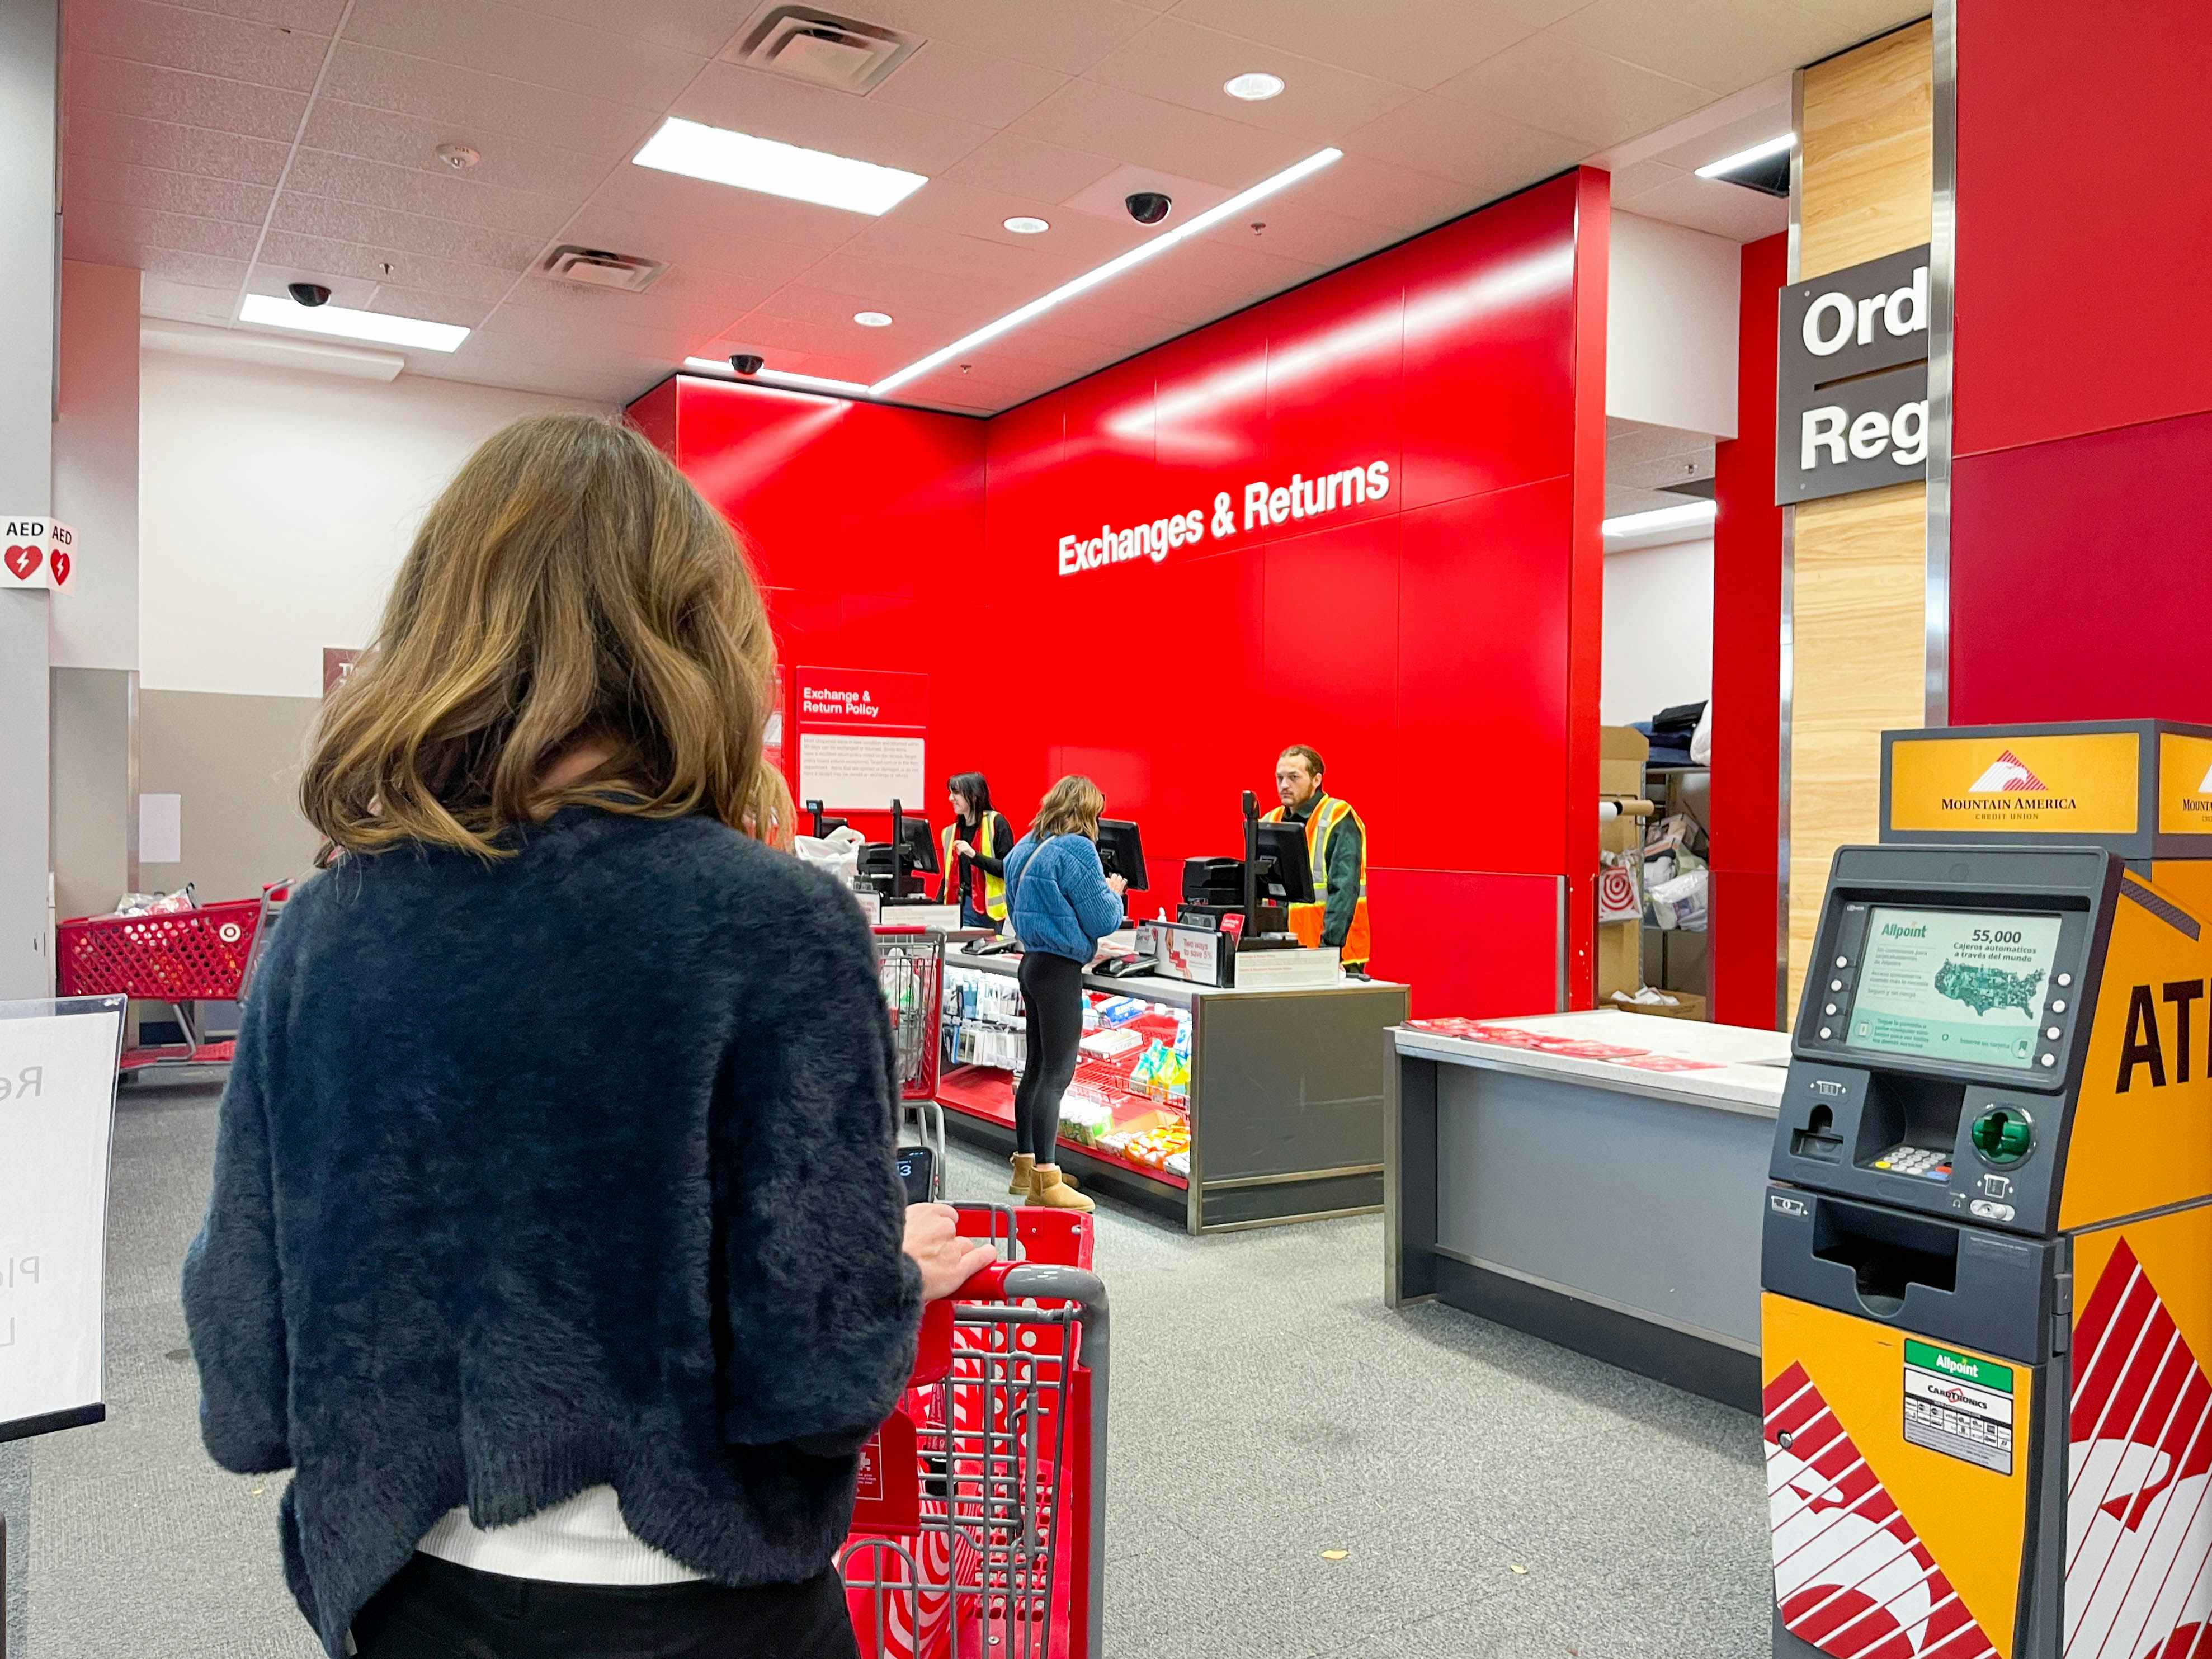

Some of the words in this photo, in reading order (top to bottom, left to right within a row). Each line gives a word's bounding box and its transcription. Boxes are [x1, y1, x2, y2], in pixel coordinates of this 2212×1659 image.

[1802, 266, 1928, 356] Ord
[1801, 399, 1928, 471] Reg
[1058, 508, 1205, 576] Exchanges
[1211, 492, 1237, 538] &
[1244, 460, 1390, 531] Returns
[6, 522, 44, 536] AED
[52, 526, 72, 545] AED
[803, 687, 860, 703] Exchange
[862, 690, 871, 702] &
[803, 700, 842, 714] Return
[845, 703, 879, 717] Policy
[1941, 799, 2011, 810] MOUNTAIN
[2014, 798, 2077, 810] AMERICA
[1881, 923, 1928, 940] Allpoint
[1972, 929, 2022, 944] 55,000
[1183, 938, 1194, 948] Two
[1195, 940, 1208, 950] ways
[1954, 942, 1983, 951] Cajeros
[1190, 950, 1202, 958] save
[1960, 950, 1986, 959] través
[1988, 952, 2001, 960] del
[2002, 954, 2032, 962] mundo
[2115, 977, 2212, 1094] AT
[1936, 1354, 1978, 1378] Allpoint
[1927, 1384, 1988, 1410] CARDTRONICS
